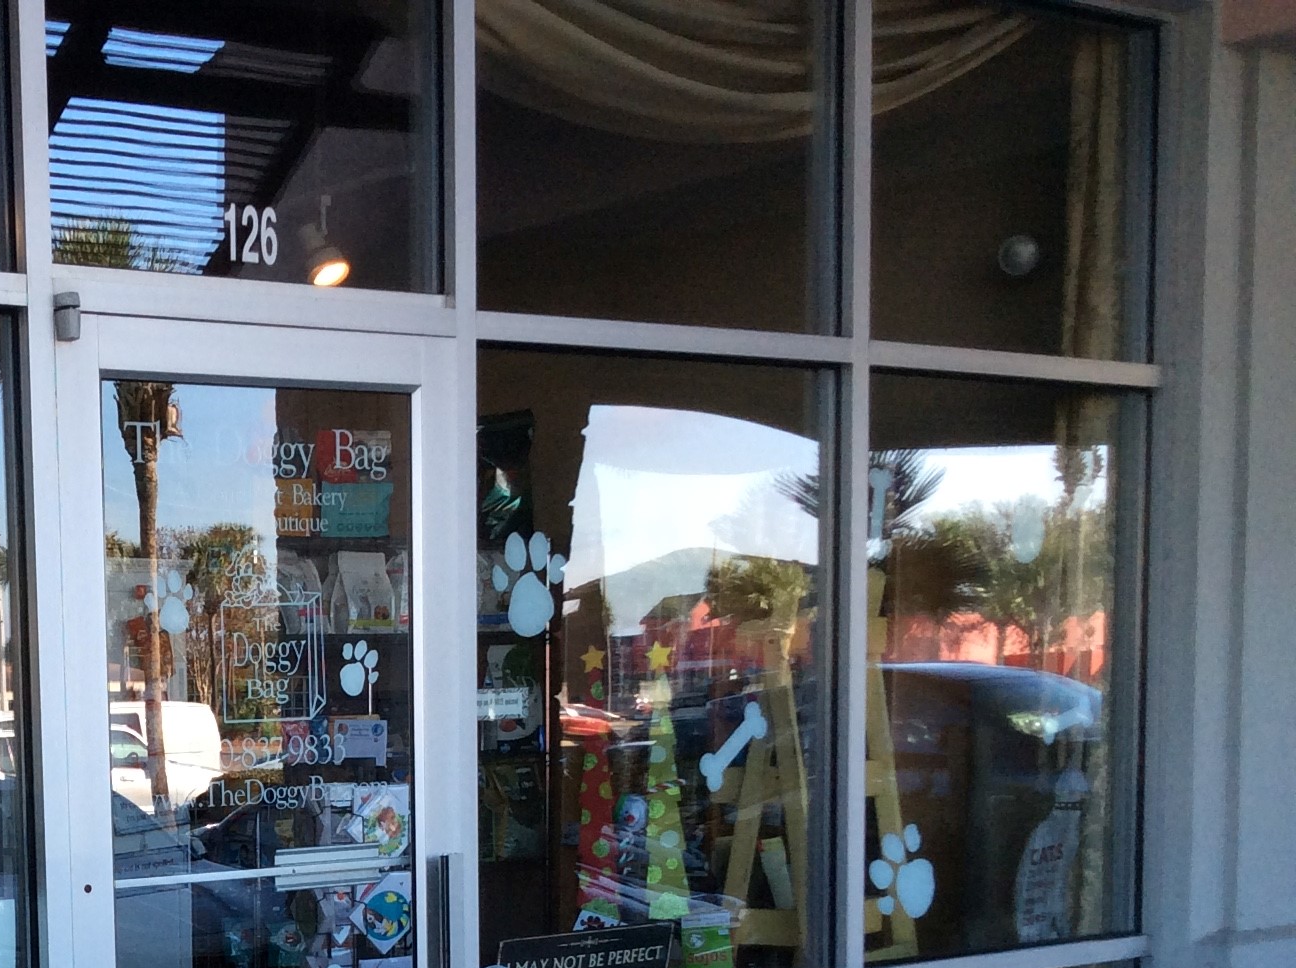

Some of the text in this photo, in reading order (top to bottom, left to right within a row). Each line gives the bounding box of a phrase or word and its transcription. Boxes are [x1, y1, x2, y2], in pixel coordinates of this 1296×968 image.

[224, 202, 278, 266] 126
[332, 428, 388, 481] Bag
[293, 484, 347, 511] Bakery
[254, 619, 281, 632] The
[232, 632, 306, 676] Doggy
[247, 678, 290, 705] Bag
[589, 953, 604, 968] BE
[608, 945, 663, 965] PERFECT
